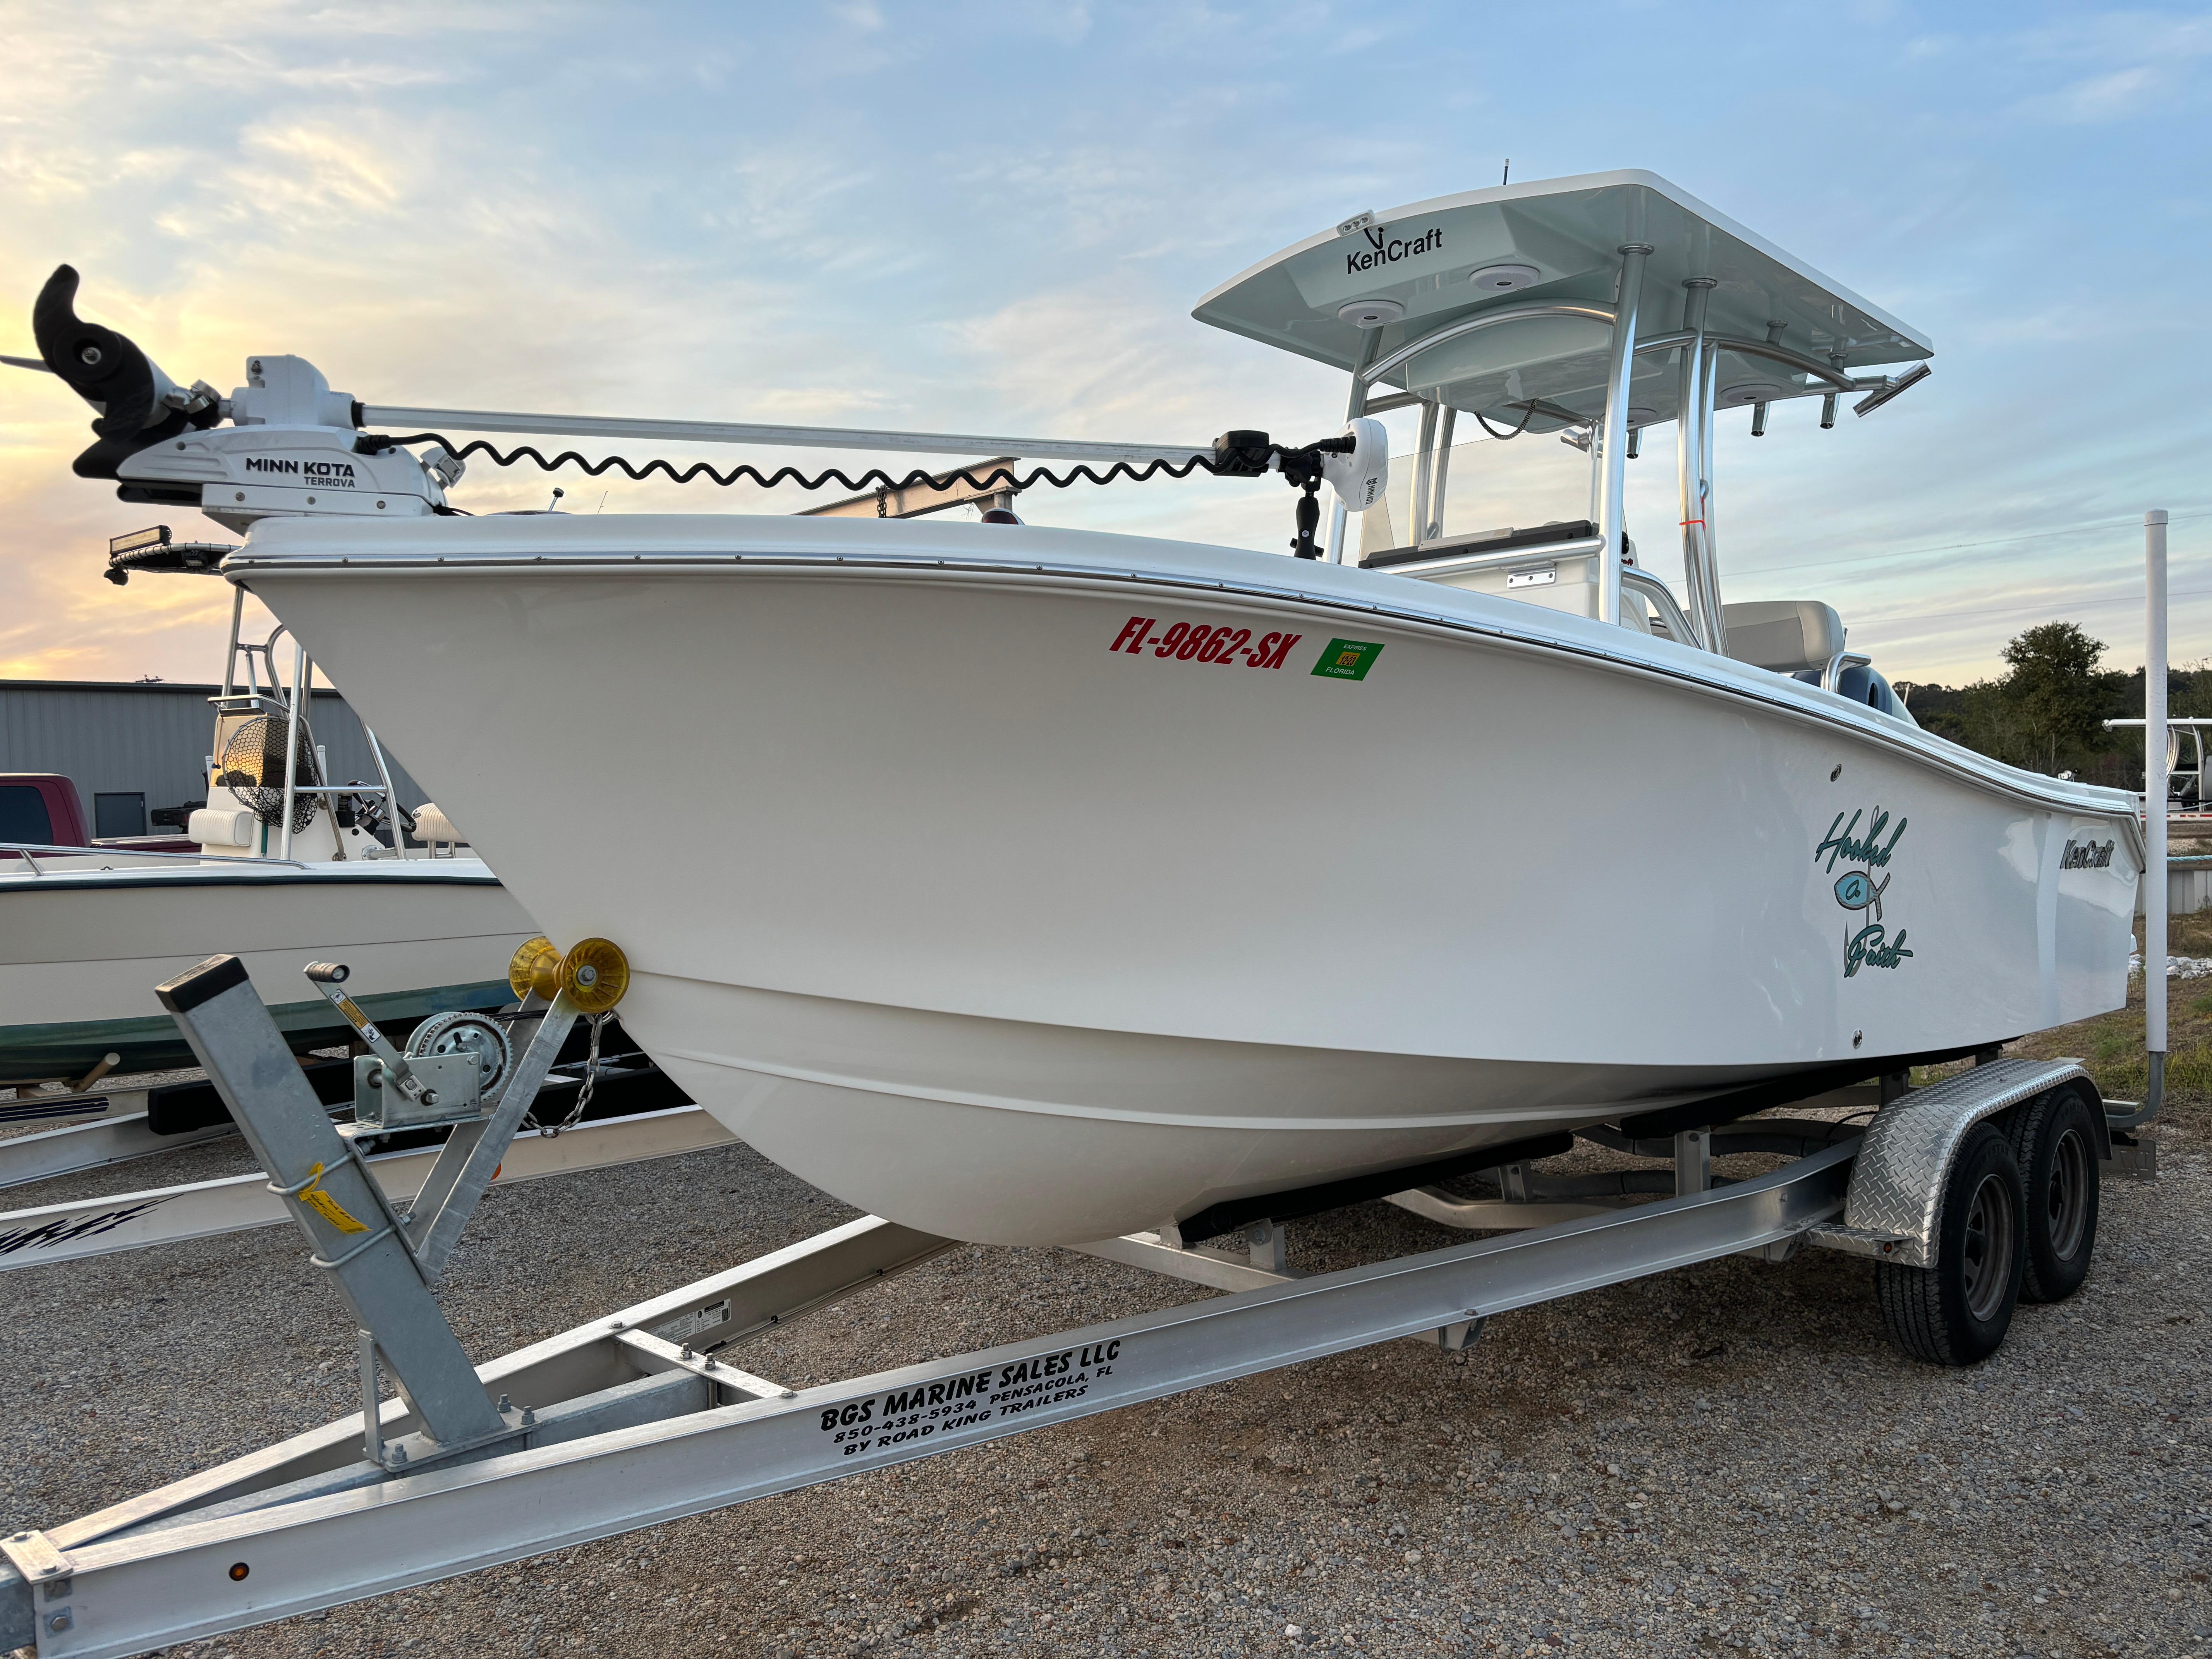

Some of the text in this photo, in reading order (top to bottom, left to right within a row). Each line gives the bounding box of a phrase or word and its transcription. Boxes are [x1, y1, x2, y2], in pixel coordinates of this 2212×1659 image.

[1347, 227, 1442, 275] KenCraft
[246, 458, 355, 477] MINN KOTA
[304, 477, 355, 488] TERROVA
[1109, 617, 1302, 669] FL-9862-SX
[1815, 809, 1907, 874] Hooked
[2059, 839, 2115, 869] KenCraft
[1844, 924, 1913, 978] Faith
[821, 1340, 1121, 1432] BGS MARINE SALES LLC
[833, 1365, 1113, 1444] 850-438-5934 PENSACOLA, FL
[844, 1385, 1089, 1456] BY ROAD KING TRAILERS
